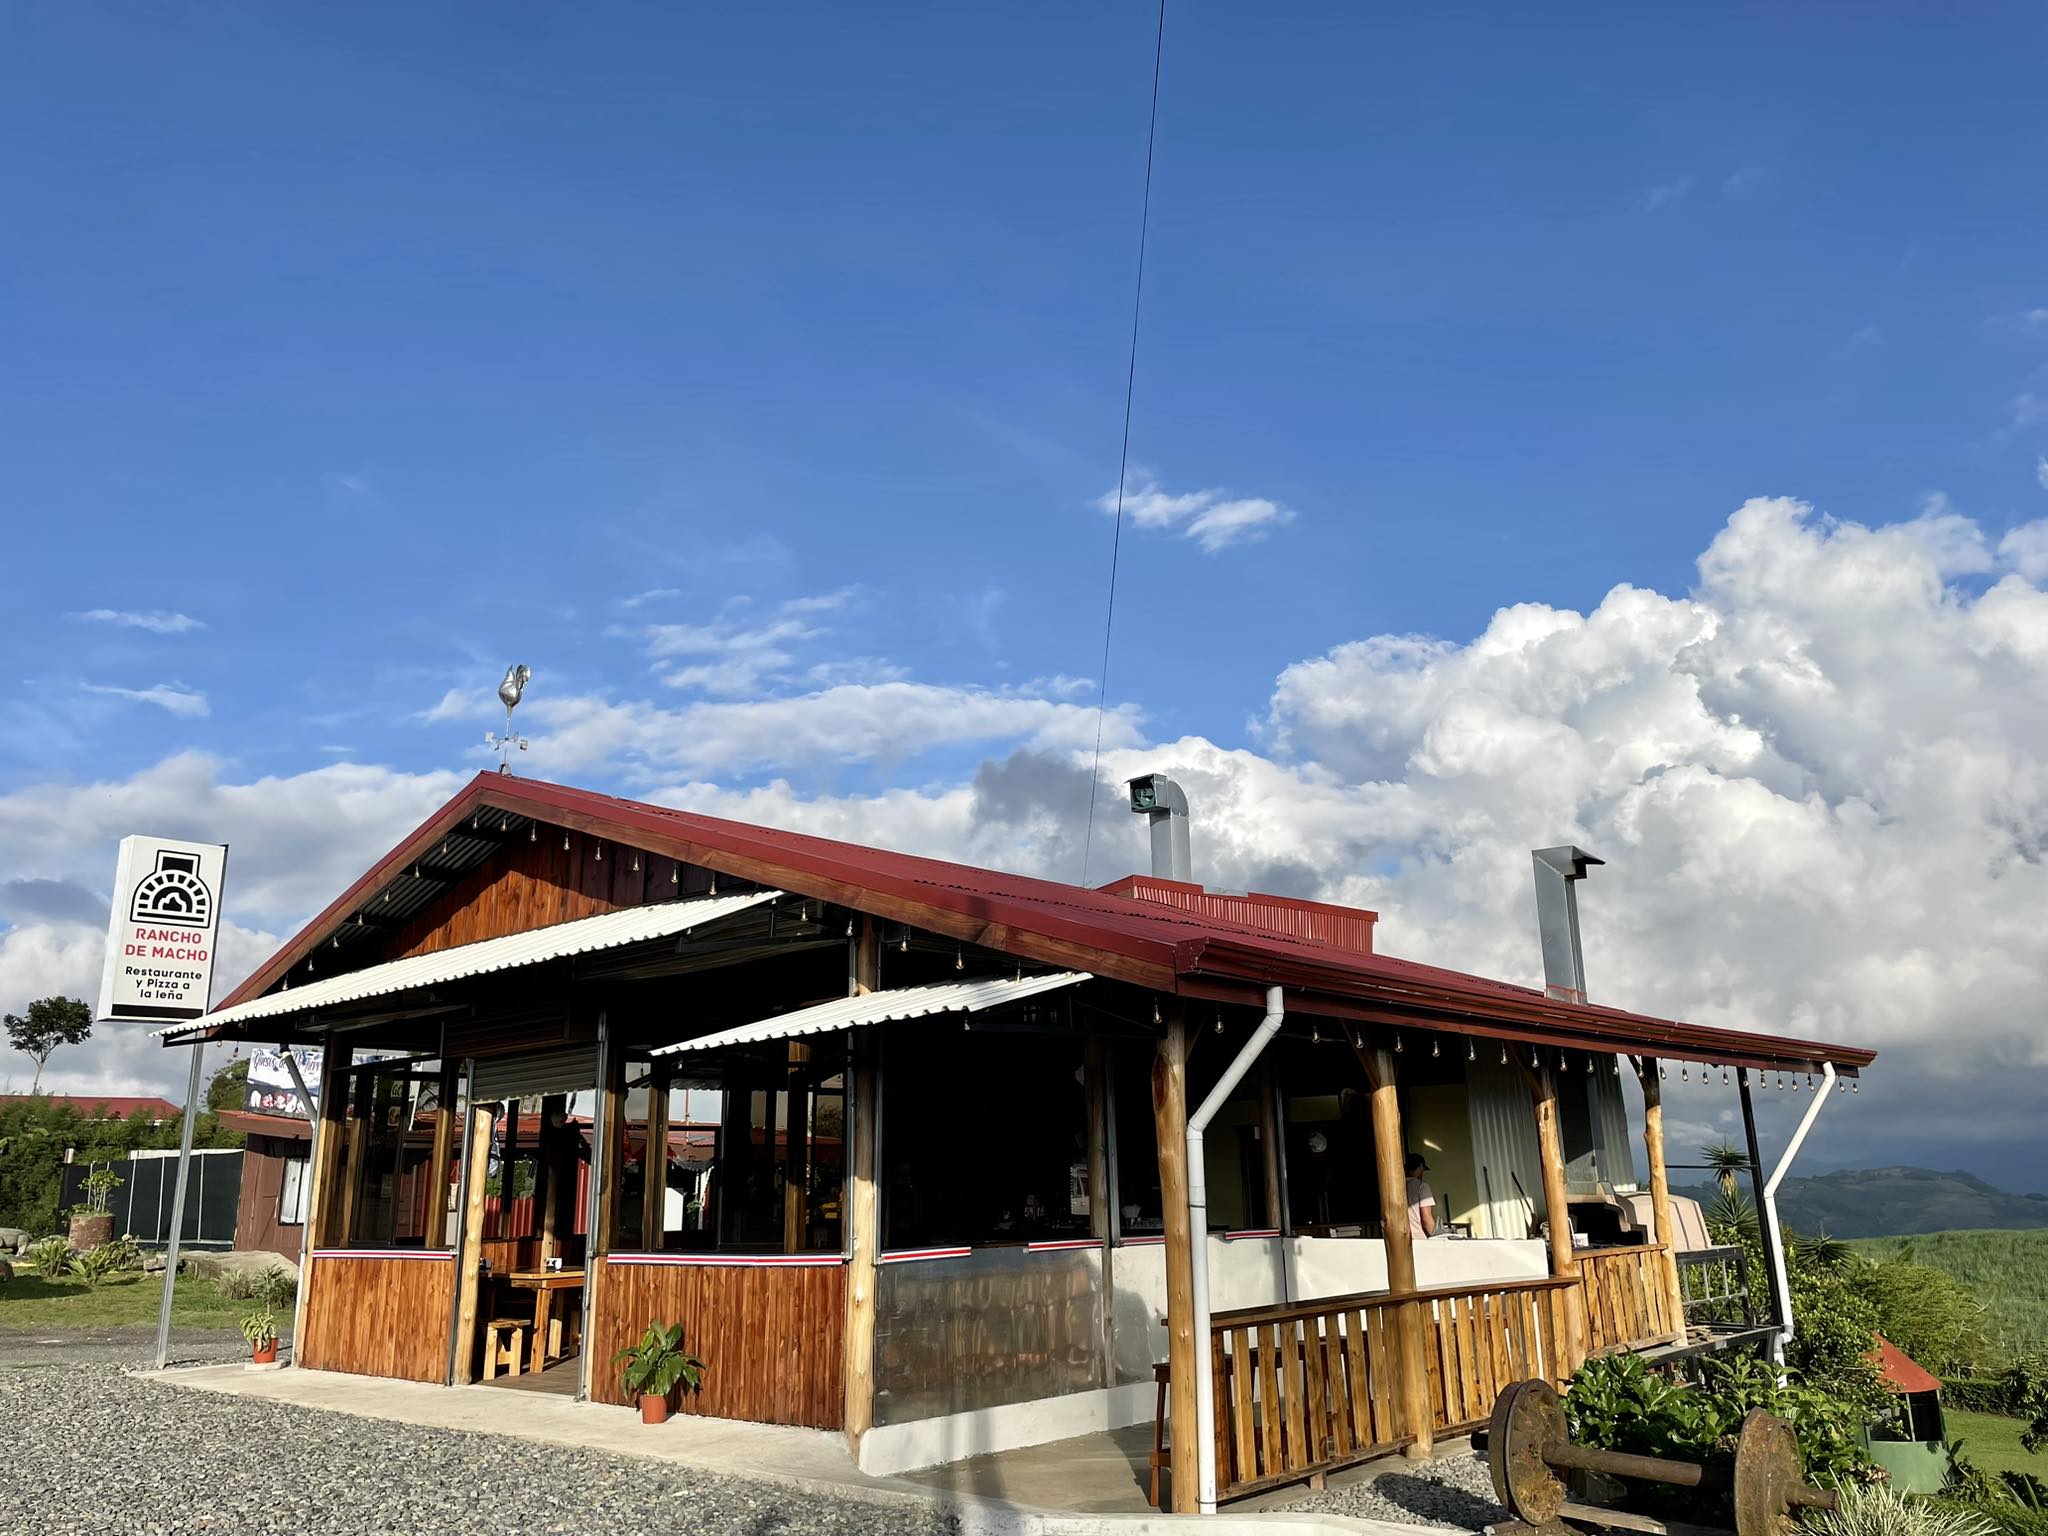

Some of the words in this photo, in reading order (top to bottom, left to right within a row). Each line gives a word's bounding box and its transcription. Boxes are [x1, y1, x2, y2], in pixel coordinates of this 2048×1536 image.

[136, 928, 201, 944] RANCHO
[125, 944, 147, 957] DE
[151, 946, 208, 961] MACHO
[125, 966, 202, 980] Restaurante
[136, 979, 143, 988] y
[147, 978, 178, 989] Pizza
[182, 982, 190, 990] a
[140, 989, 152, 998] la
[156, 989, 183, 1000] leña
